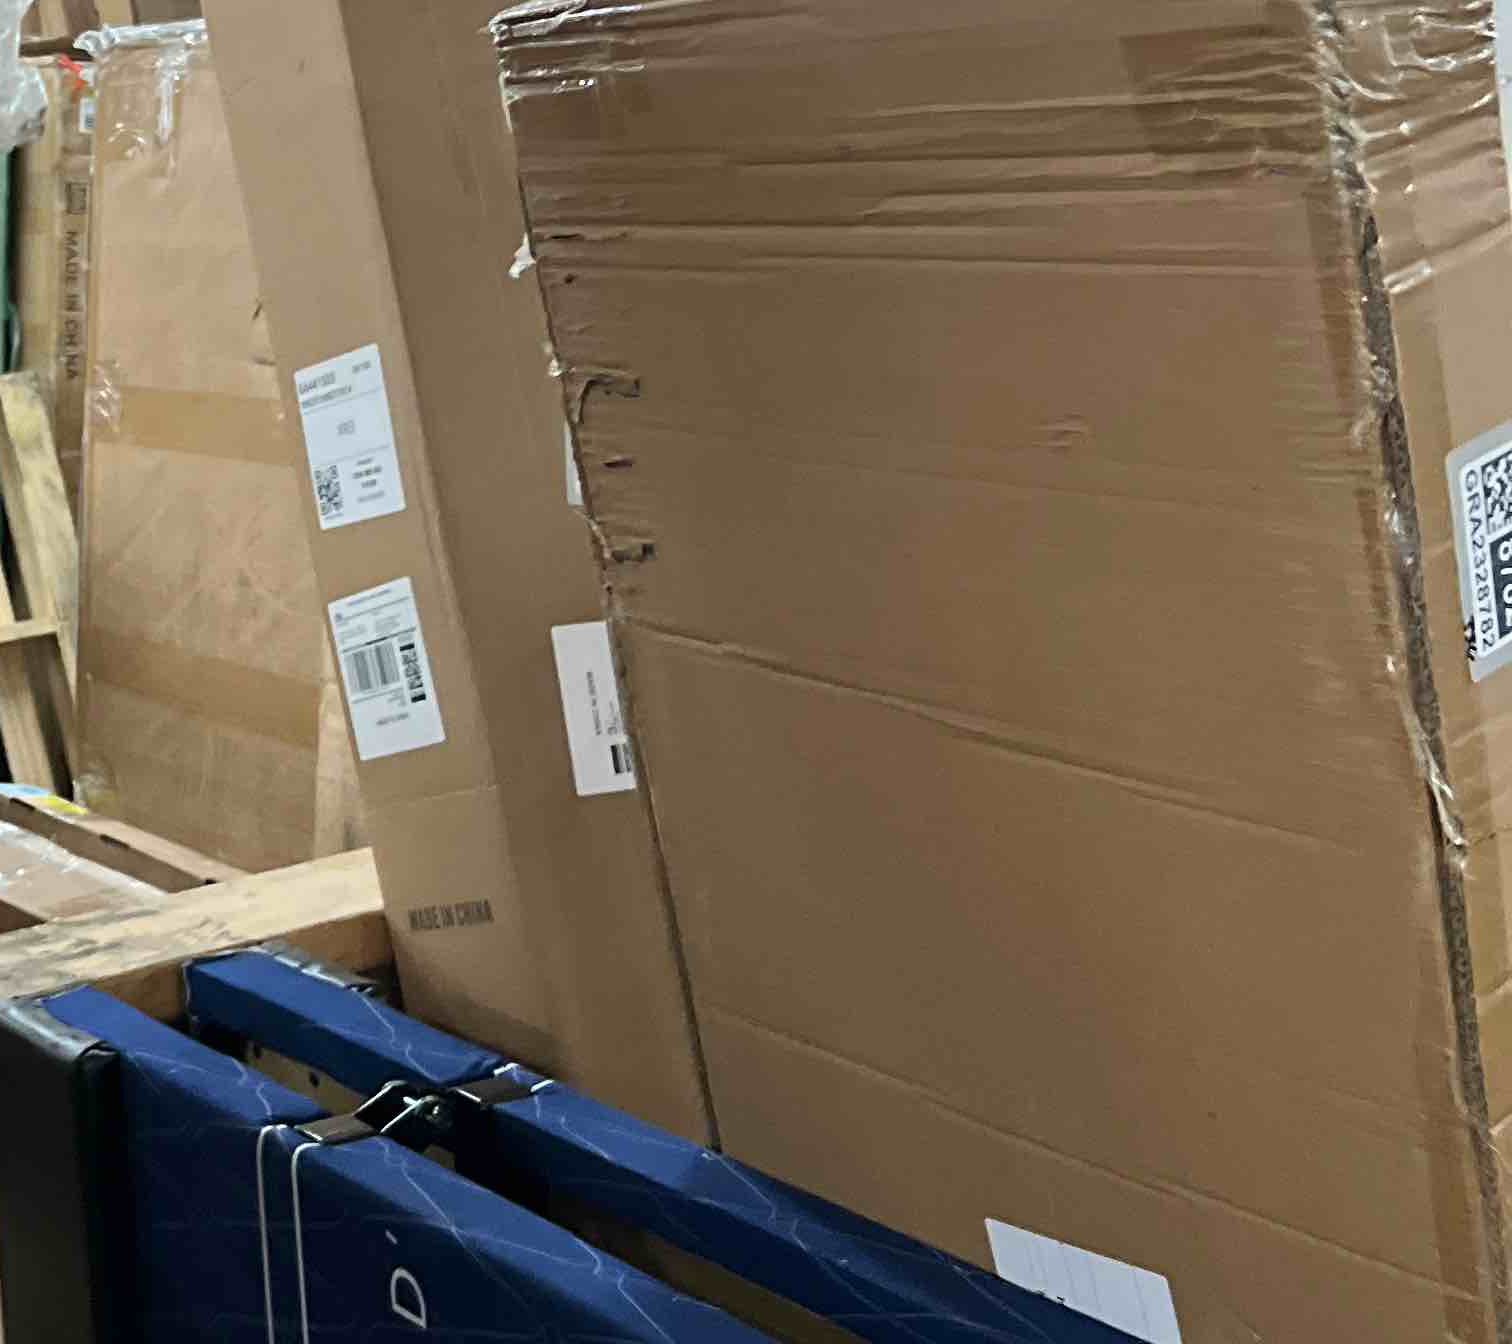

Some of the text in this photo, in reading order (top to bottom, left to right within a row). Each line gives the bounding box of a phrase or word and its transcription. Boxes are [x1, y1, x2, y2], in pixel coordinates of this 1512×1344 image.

[64, 230, 80, 381] MADE IN CHINA
[1464, 469, 1496, 649] GRA2328782
[408, 906, 441, 931] MADE
